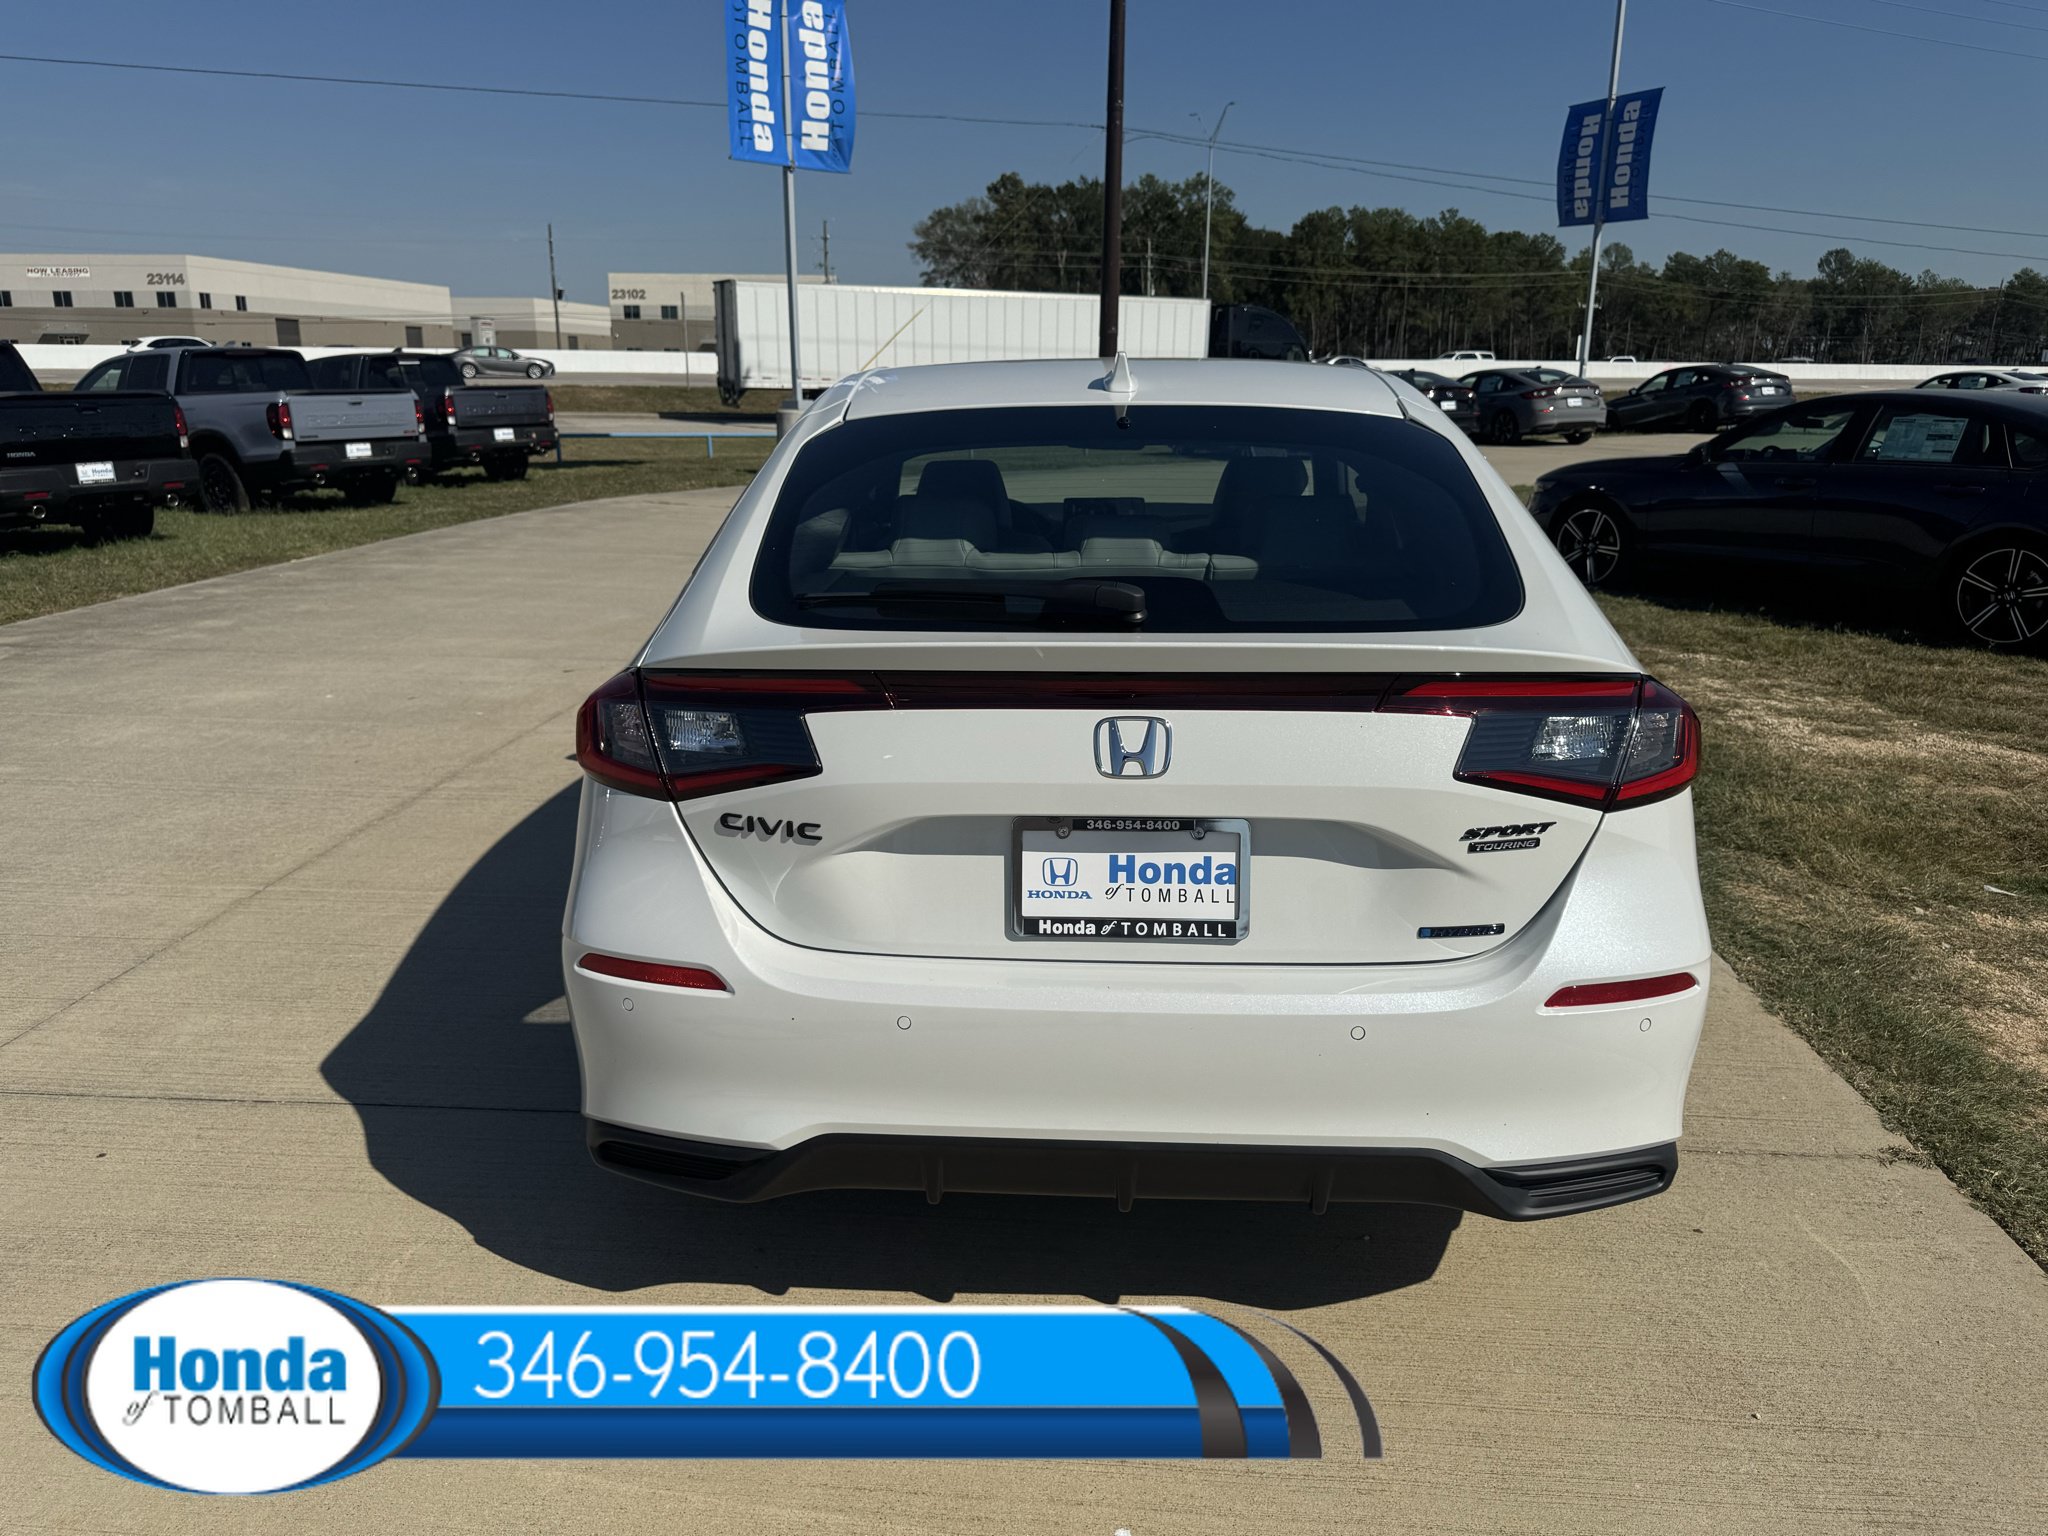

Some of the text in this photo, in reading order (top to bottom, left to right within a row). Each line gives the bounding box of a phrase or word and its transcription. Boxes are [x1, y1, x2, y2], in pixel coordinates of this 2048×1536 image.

[734, 16, 752, 146] TOMBALL
[748, 0, 775, 152] Honda
[798, 1, 830, 151] Honda
[1610, 100, 1642, 209] Honda
[1574, 113, 1602, 218] Honda
[146, 272, 185, 285] 23114
[611, 288, 646, 300] 23102
[719, 812, 823, 842] CIVIC
[1086, 819, 1180, 830] 346-954-8400
[1459, 821, 1557, 841] SPORT
[1475, 839, 1537, 852] TOURING
[1109, 854, 1236, 885] Honda
[1027, 889, 1092, 900] HONDA
[1104, 883, 1235, 903] of TOMBALL
[1038, 919, 1226, 938] Honda of TOMBALL
